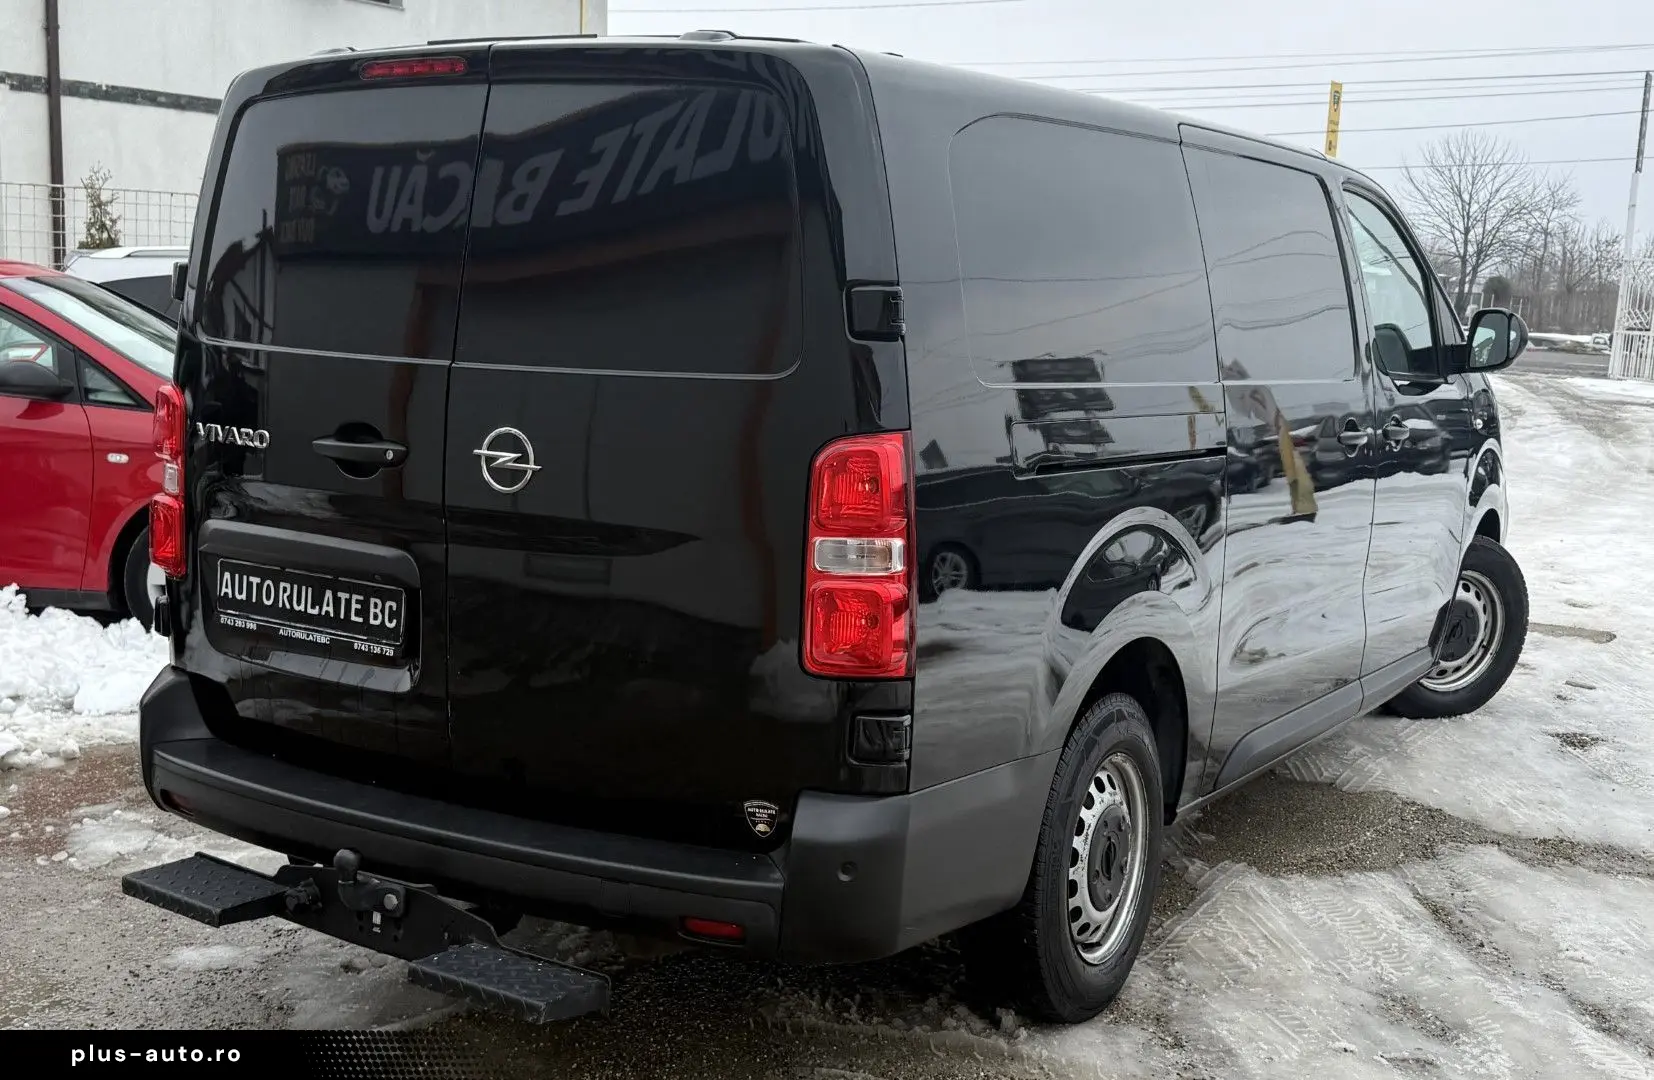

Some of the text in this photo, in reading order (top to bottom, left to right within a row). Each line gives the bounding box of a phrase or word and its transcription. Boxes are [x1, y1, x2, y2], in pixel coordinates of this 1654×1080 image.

[196, 422, 270, 448] VIVARO
[369, 597, 397, 629] BC
[279, 629, 330, 644] AUTORULATEBC
[353, 642, 368, 652] 0743
